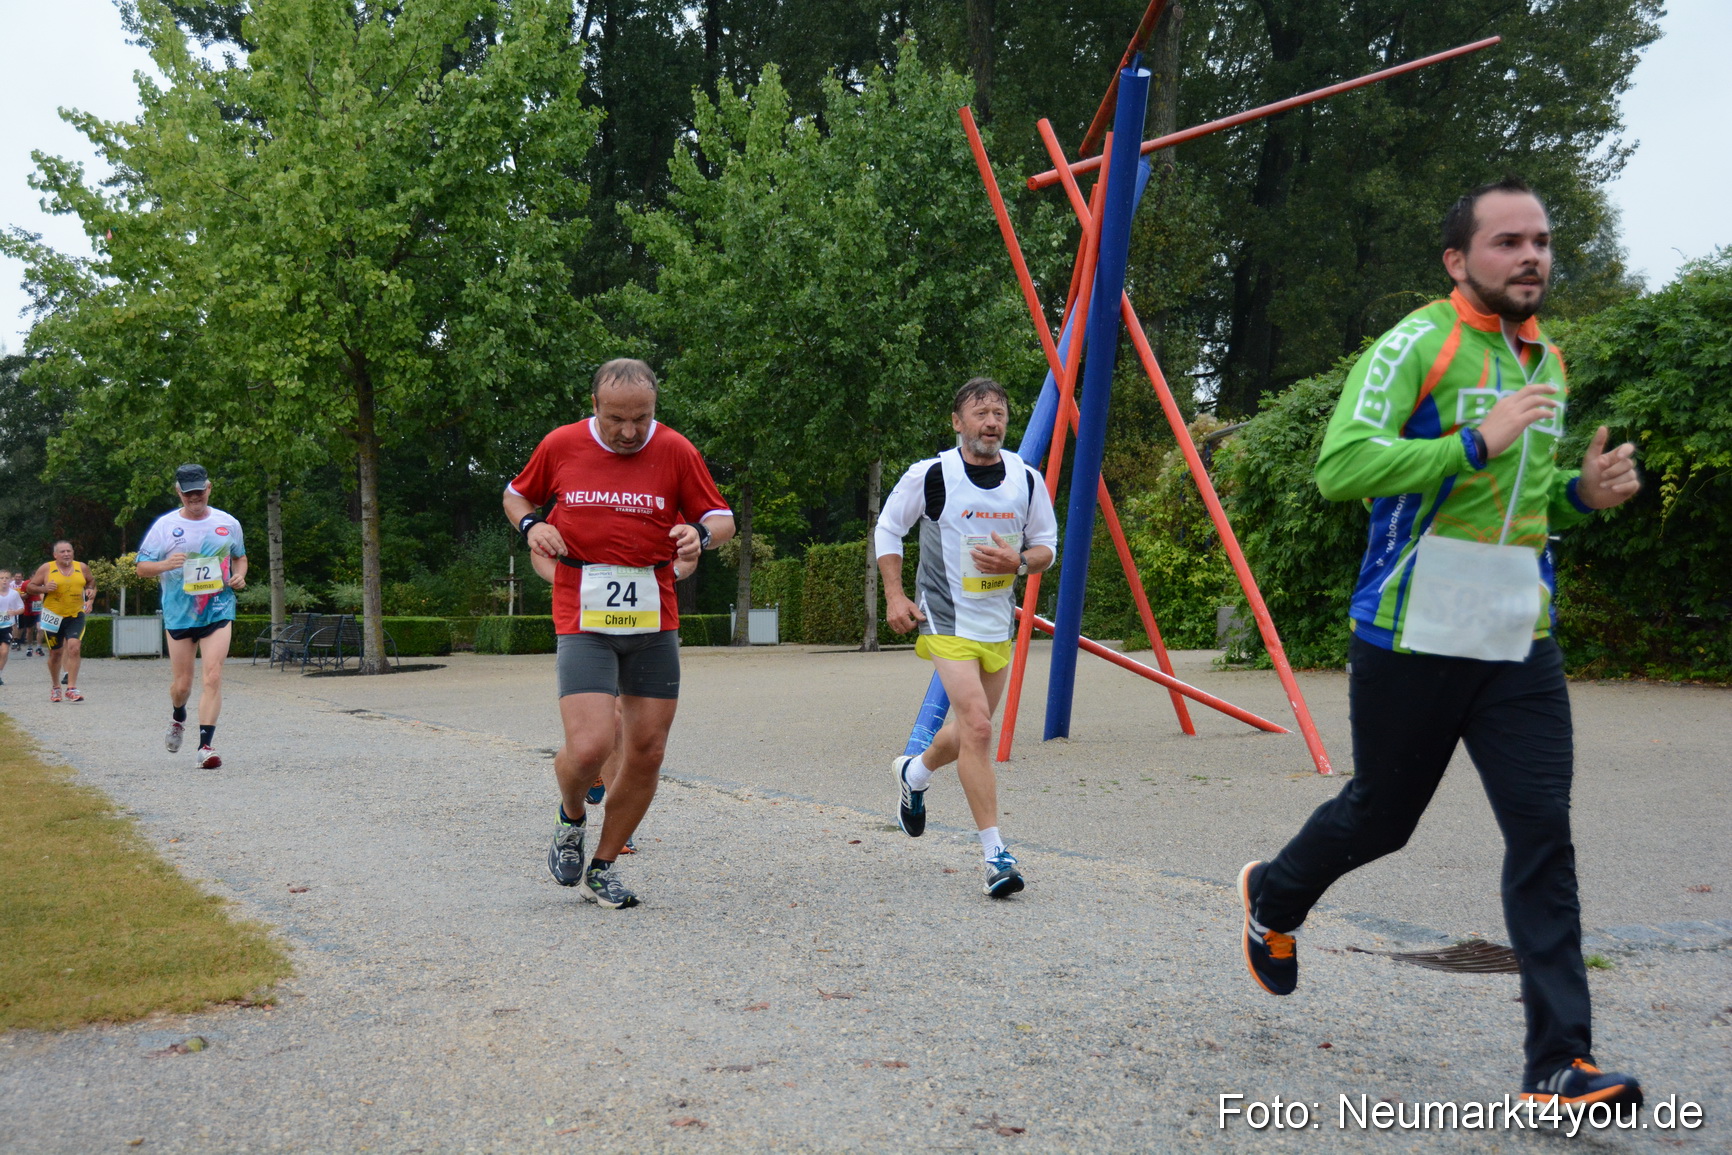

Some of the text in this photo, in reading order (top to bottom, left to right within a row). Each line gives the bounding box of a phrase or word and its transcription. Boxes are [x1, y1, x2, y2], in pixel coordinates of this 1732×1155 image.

[1352, 318, 1437, 429] BOCK
[565, 491, 653, 507] NEUMARKT
[975, 511, 1017, 520] KLEBL
[195, 566, 211, 581] 72
[193, 583, 215, 591] Thomas
[981, 579, 1005, 590] Rainer
[606, 580, 638, 608] 24
[605, 614, 637, 627] Charly
